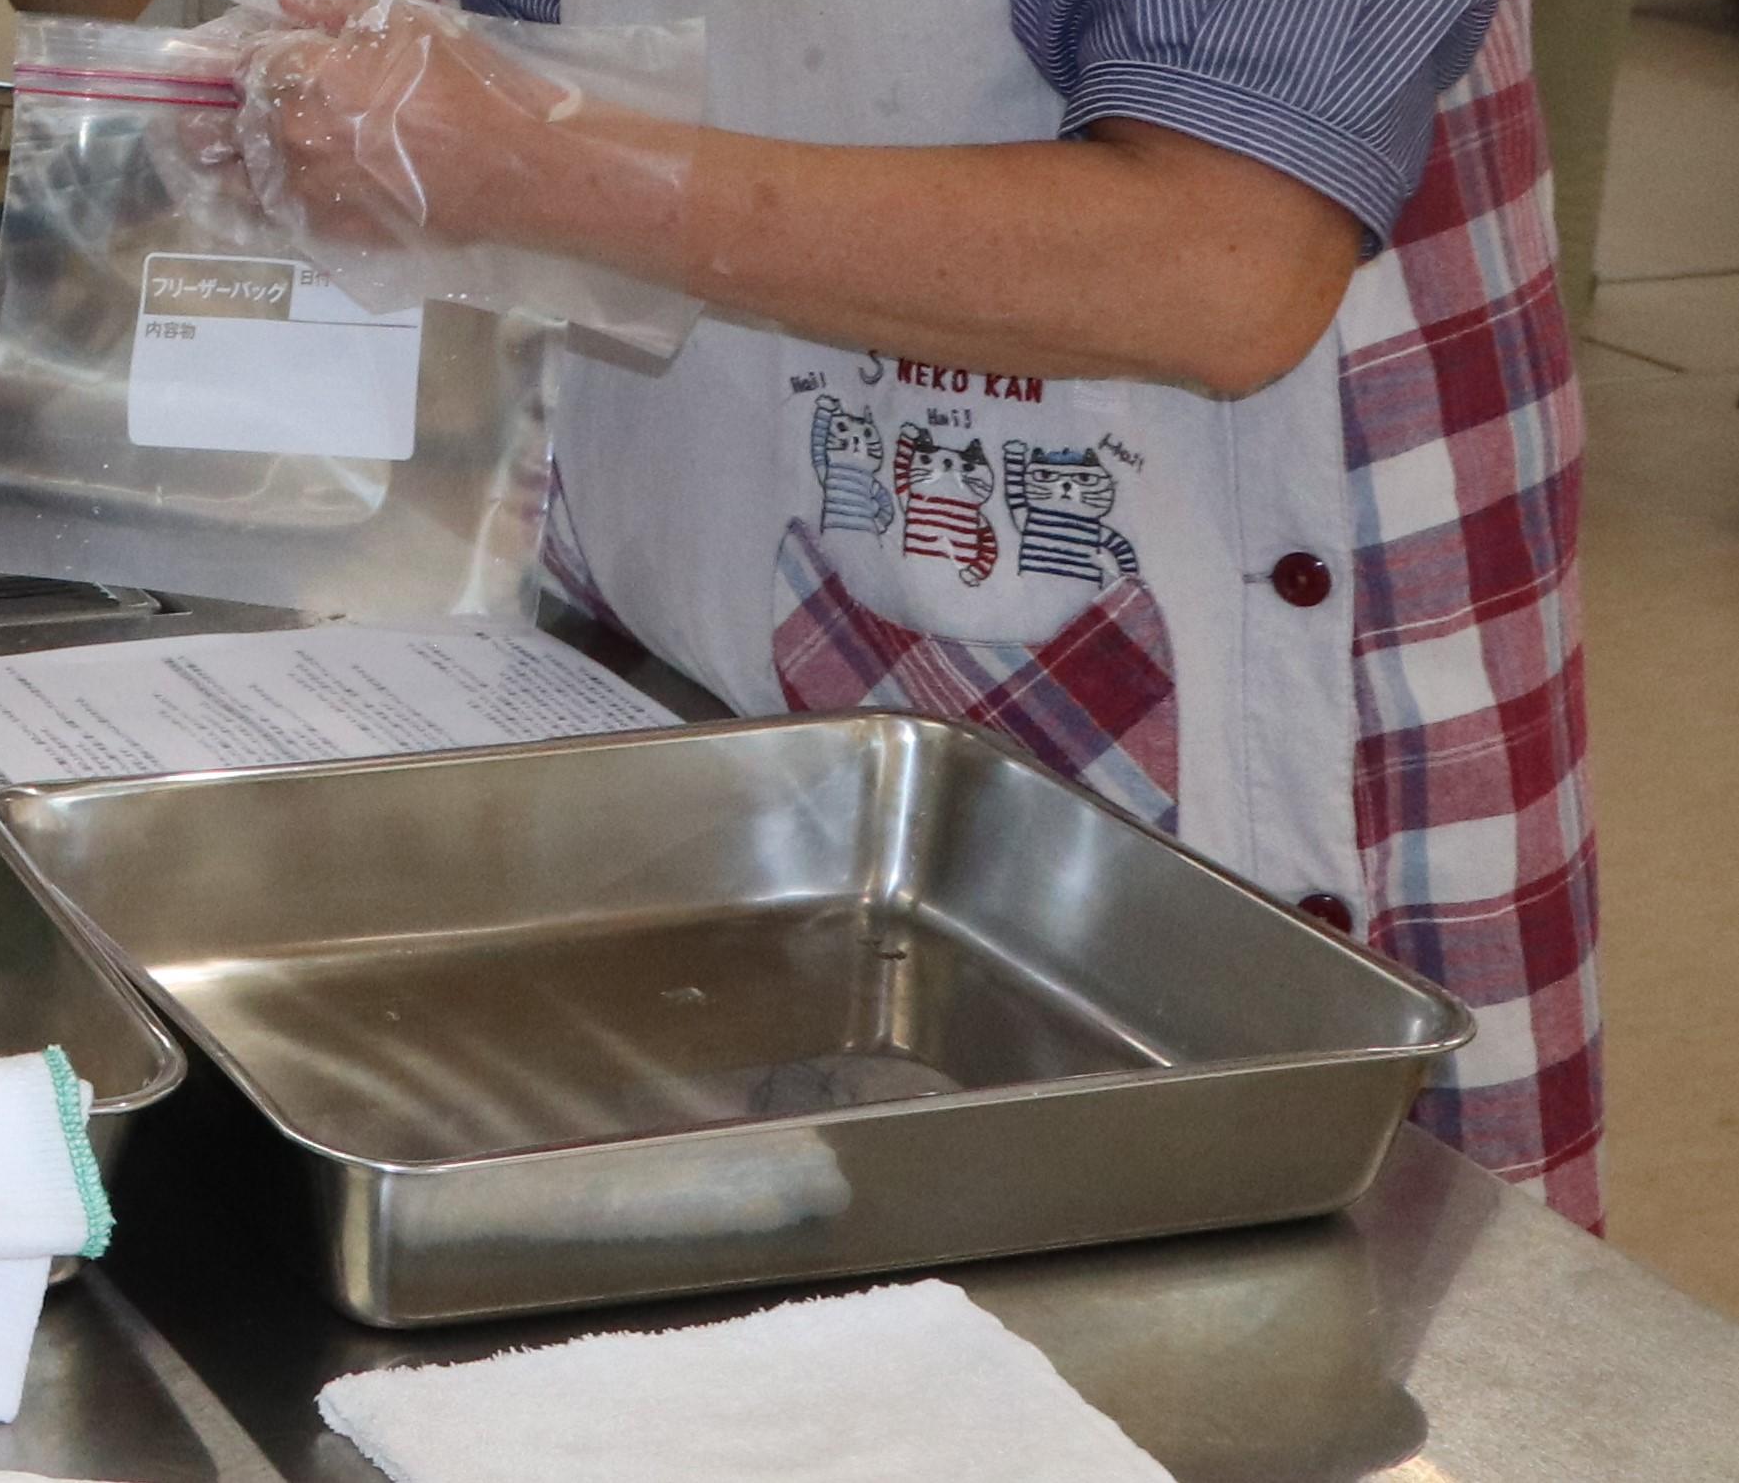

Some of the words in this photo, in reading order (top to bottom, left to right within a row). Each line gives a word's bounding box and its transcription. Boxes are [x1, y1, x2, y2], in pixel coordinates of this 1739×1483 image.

[151, 276, 288, 304] フリーザーバッグ
[144, 320, 197, 340] 内容物
[897, 357, 969, 394] NEKO
[983, 373, 1044, 404] KAN
